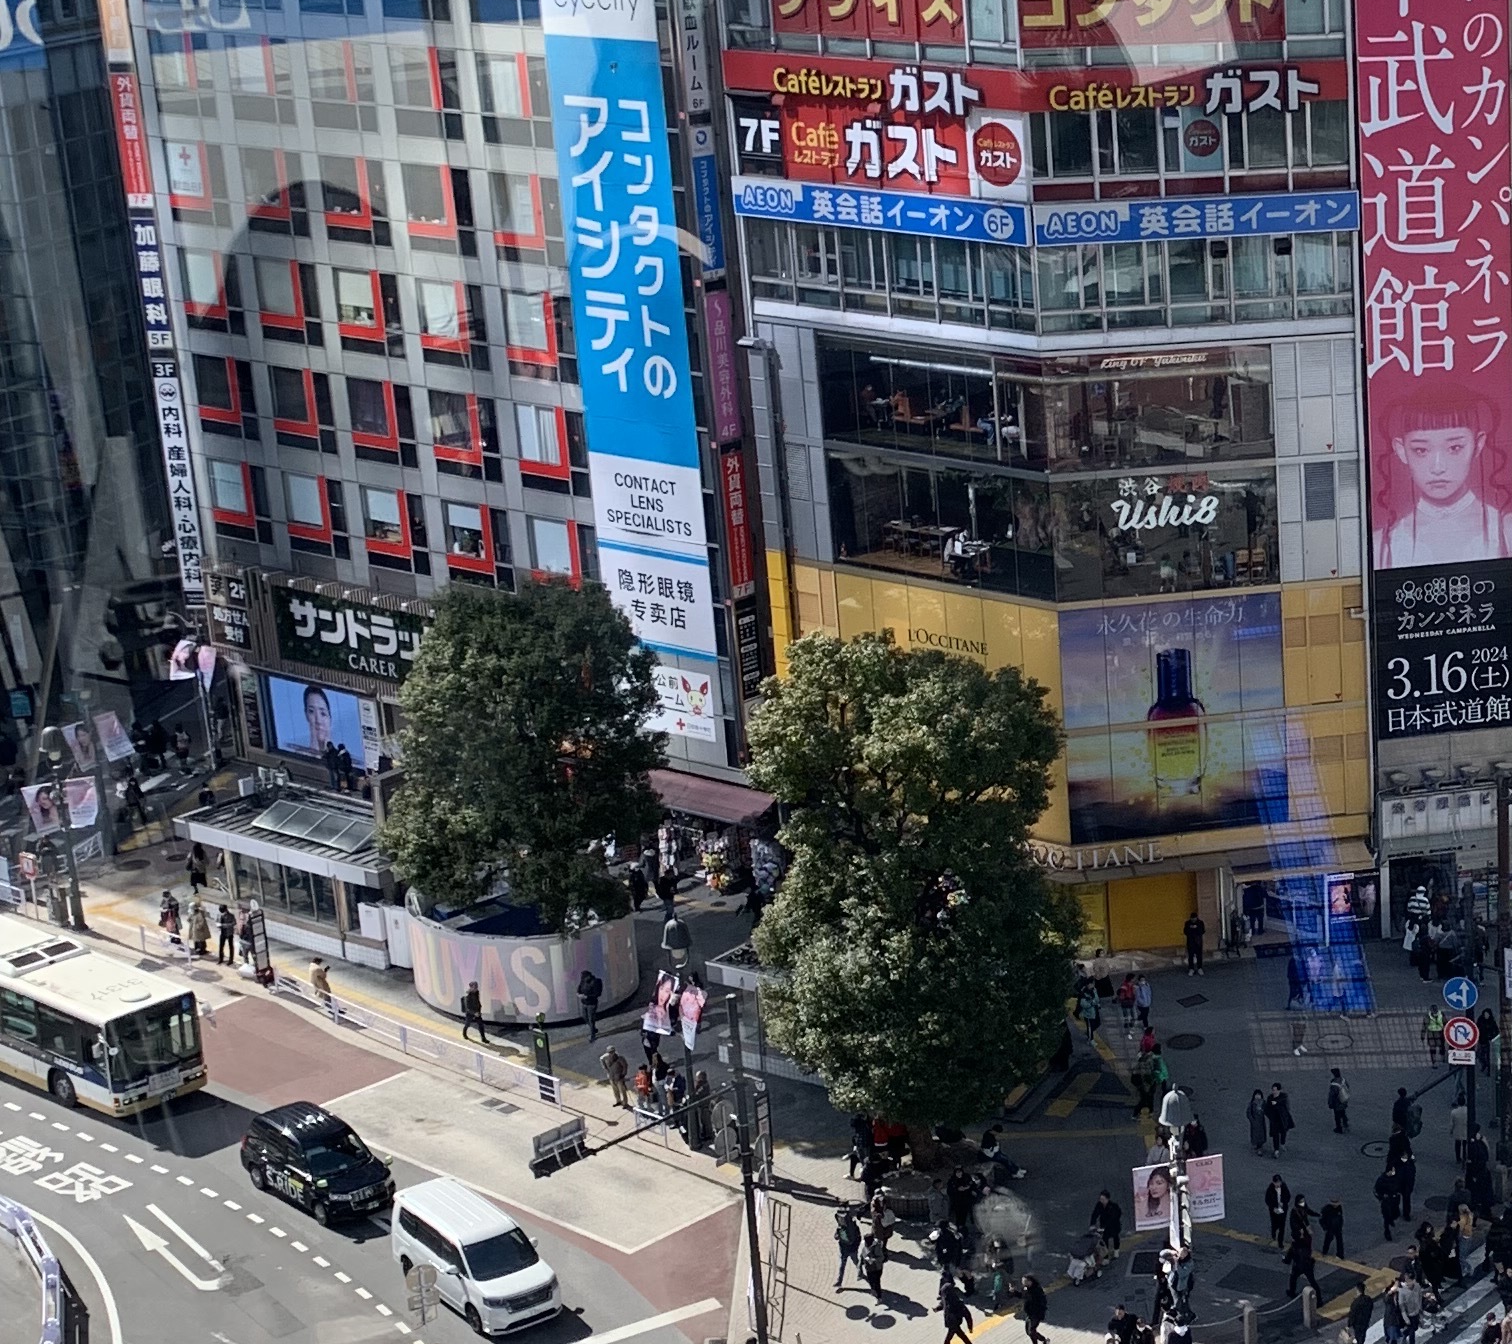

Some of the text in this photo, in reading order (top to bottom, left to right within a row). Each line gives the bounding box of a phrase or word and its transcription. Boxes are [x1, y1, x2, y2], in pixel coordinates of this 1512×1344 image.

[773, 66, 980, 116] Caféレストラン ガスト
[1049, 69, 1320, 114] Caféレストラン ガスト
[739, 118, 780, 154] 7F
[791, 121, 839, 150] Café
[845, 120, 957, 182] ガスト
[1189, 135, 1218, 147] ガスト
[980, 150, 1018, 170] ガスト
[744, 186, 1011, 234] AEON 英会話イーオン 6F
[1048, 198, 1351, 236] AEON 英会話イーオン
[562, 94, 633, 395] アイシティ
[617, 96, 679, 401] コンタクトの
[134, 223, 168, 325] 加藤眼科
[151, 332, 170, 346] 5F
[155, 363, 175, 377] 3F
[162, 406, 183, 439] 内科
[721, 424, 738, 438] 4F
[614, 472, 677, 497] CONTACT
[726, 456, 745, 527] 外貨両替
[1118, 476, 1163, 497] 渋谷
[630, 493, 664, 514] LENS
[1111, 494, 1220, 531] Ushi8
[607, 508, 692, 538] SPECIALISTS
[618, 567, 696, 605] 隐形眼镜
[736, 583, 752, 599] 7F
[213, 607, 250, 627] 処方せん
[631, 598, 687, 630] 专卖店
[1096, 604, 1245, 637] 永久花の生命力
[1397, 602, 1496, 632] カンパネラ
[223, 625, 245, 644] 受付
[908, 627, 990, 657] L'OCCITANE
[1397, 624, 1497, 640] WEDNESDAY CAMPANELLA
[1387, 645, 1509, 700] 3.16 2024
[1471, 663, 1510, 692] (土)
[1388, 694, 1512, 733] 日本武道館
